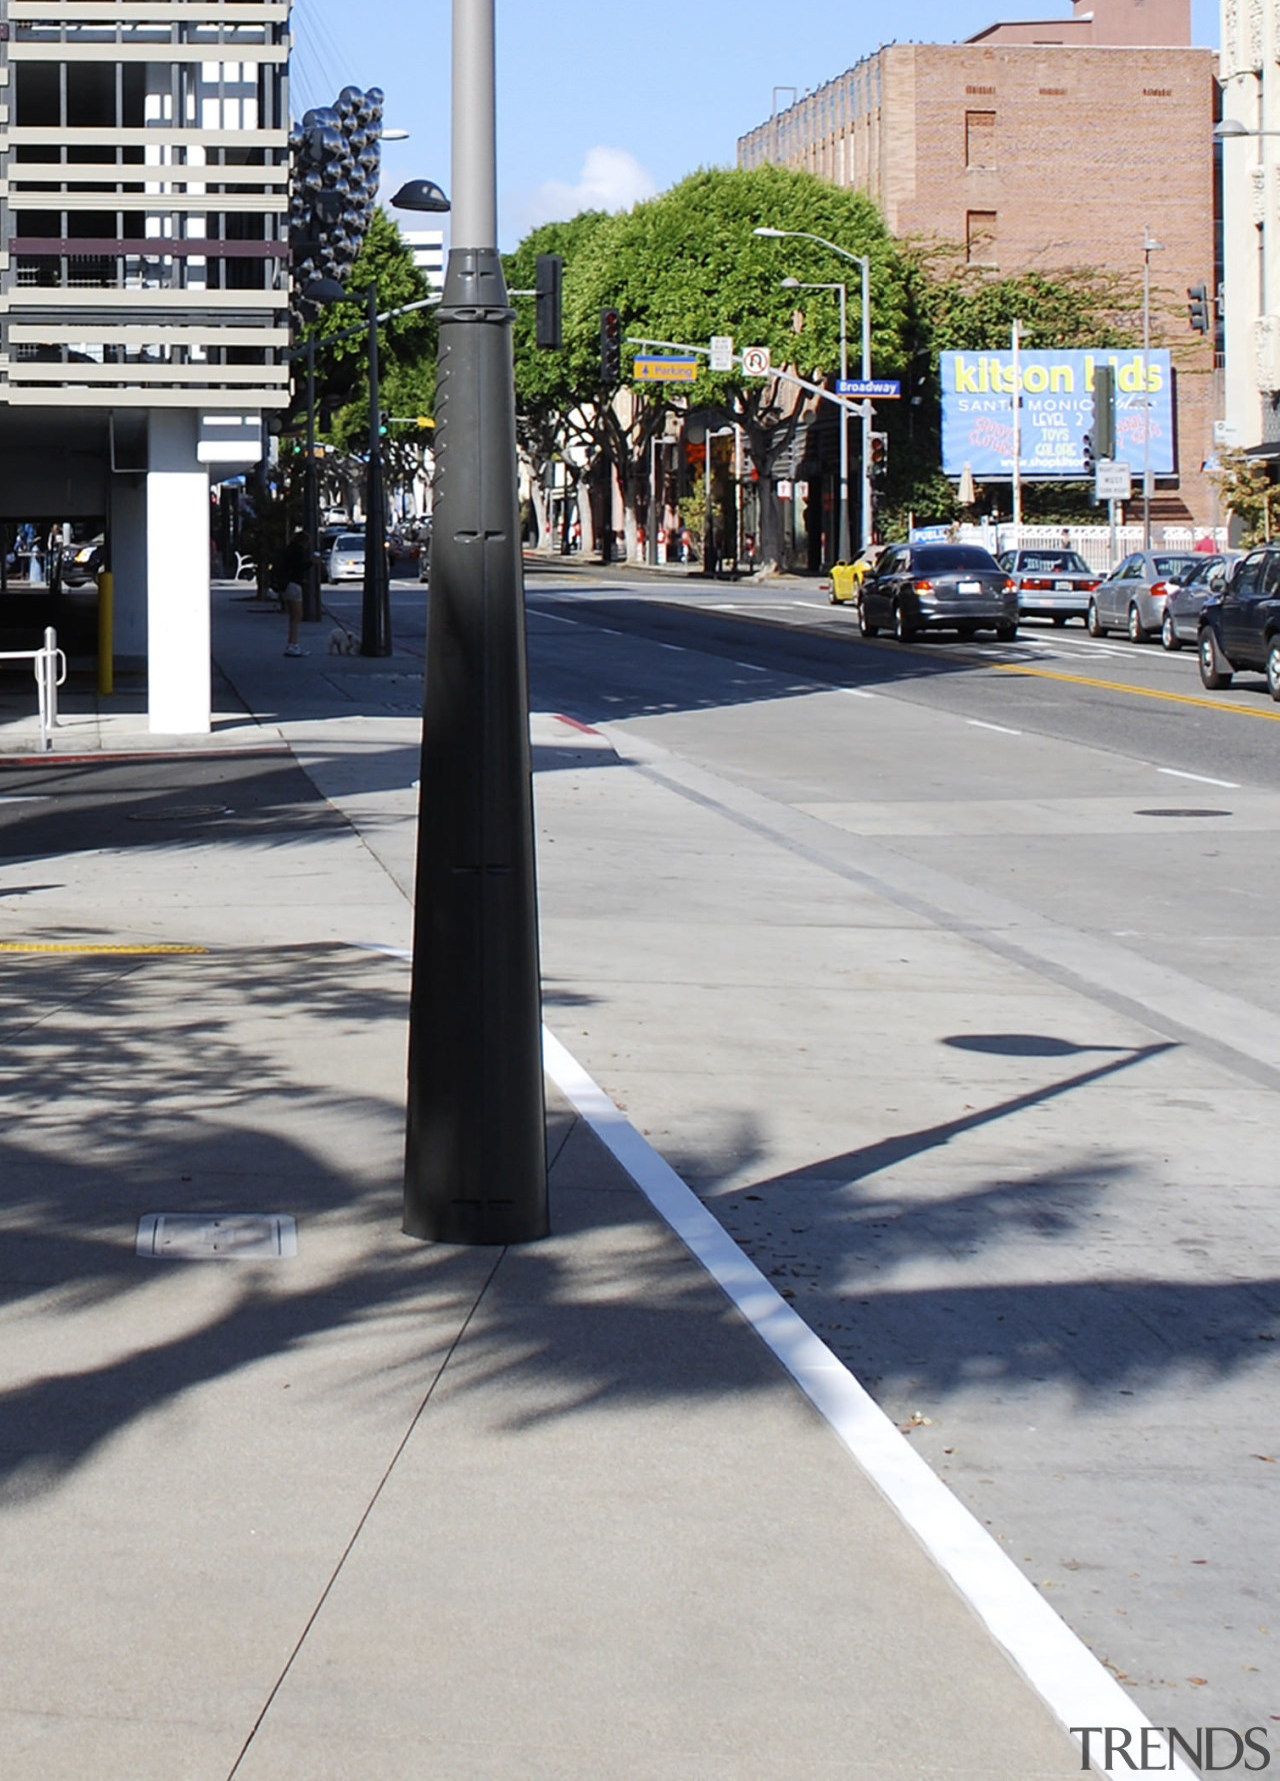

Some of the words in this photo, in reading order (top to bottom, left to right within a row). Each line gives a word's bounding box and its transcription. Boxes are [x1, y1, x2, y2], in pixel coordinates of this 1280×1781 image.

[654, 365, 693, 377] Parking
[954, 356, 1074, 394] kitson
[840, 381, 896, 395] Broadway
[958, 399, 1018, 412] SANT
[1028, 399, 1094, 412] MONIC
[1032, 412, 1068, 427] LEVEL
[1075, 412, 1084, 427] 2
[1041, 428, 1070, 442] TOYS
